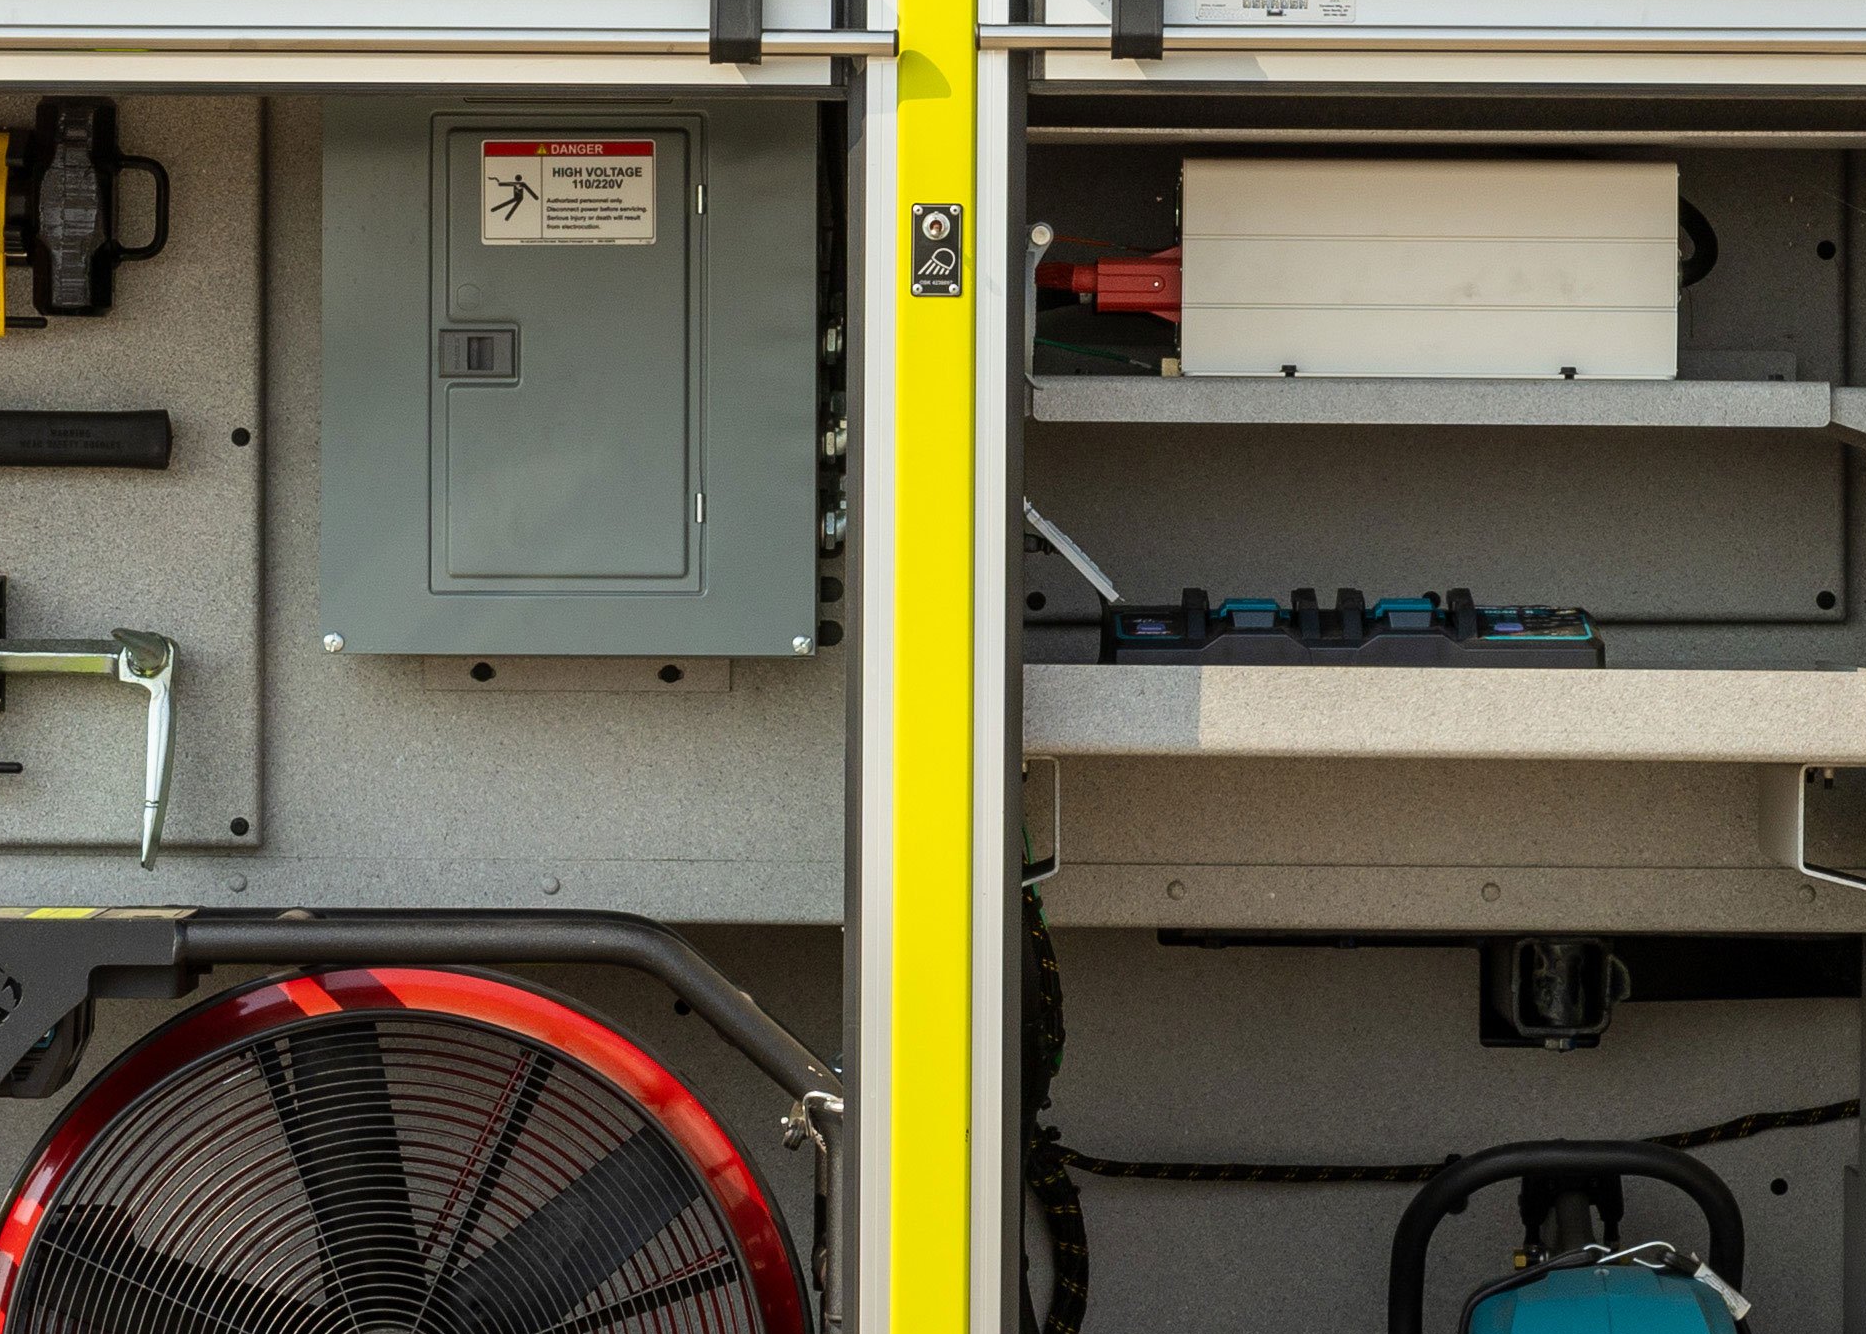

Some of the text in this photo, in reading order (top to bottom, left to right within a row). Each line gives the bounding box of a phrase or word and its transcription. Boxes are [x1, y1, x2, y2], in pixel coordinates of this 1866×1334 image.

[551, 144, 604, 155] DANGER
[552, 167, 643, 178] HIGH VOLTAGE
[572, 179, 624, 190] 110/220V
